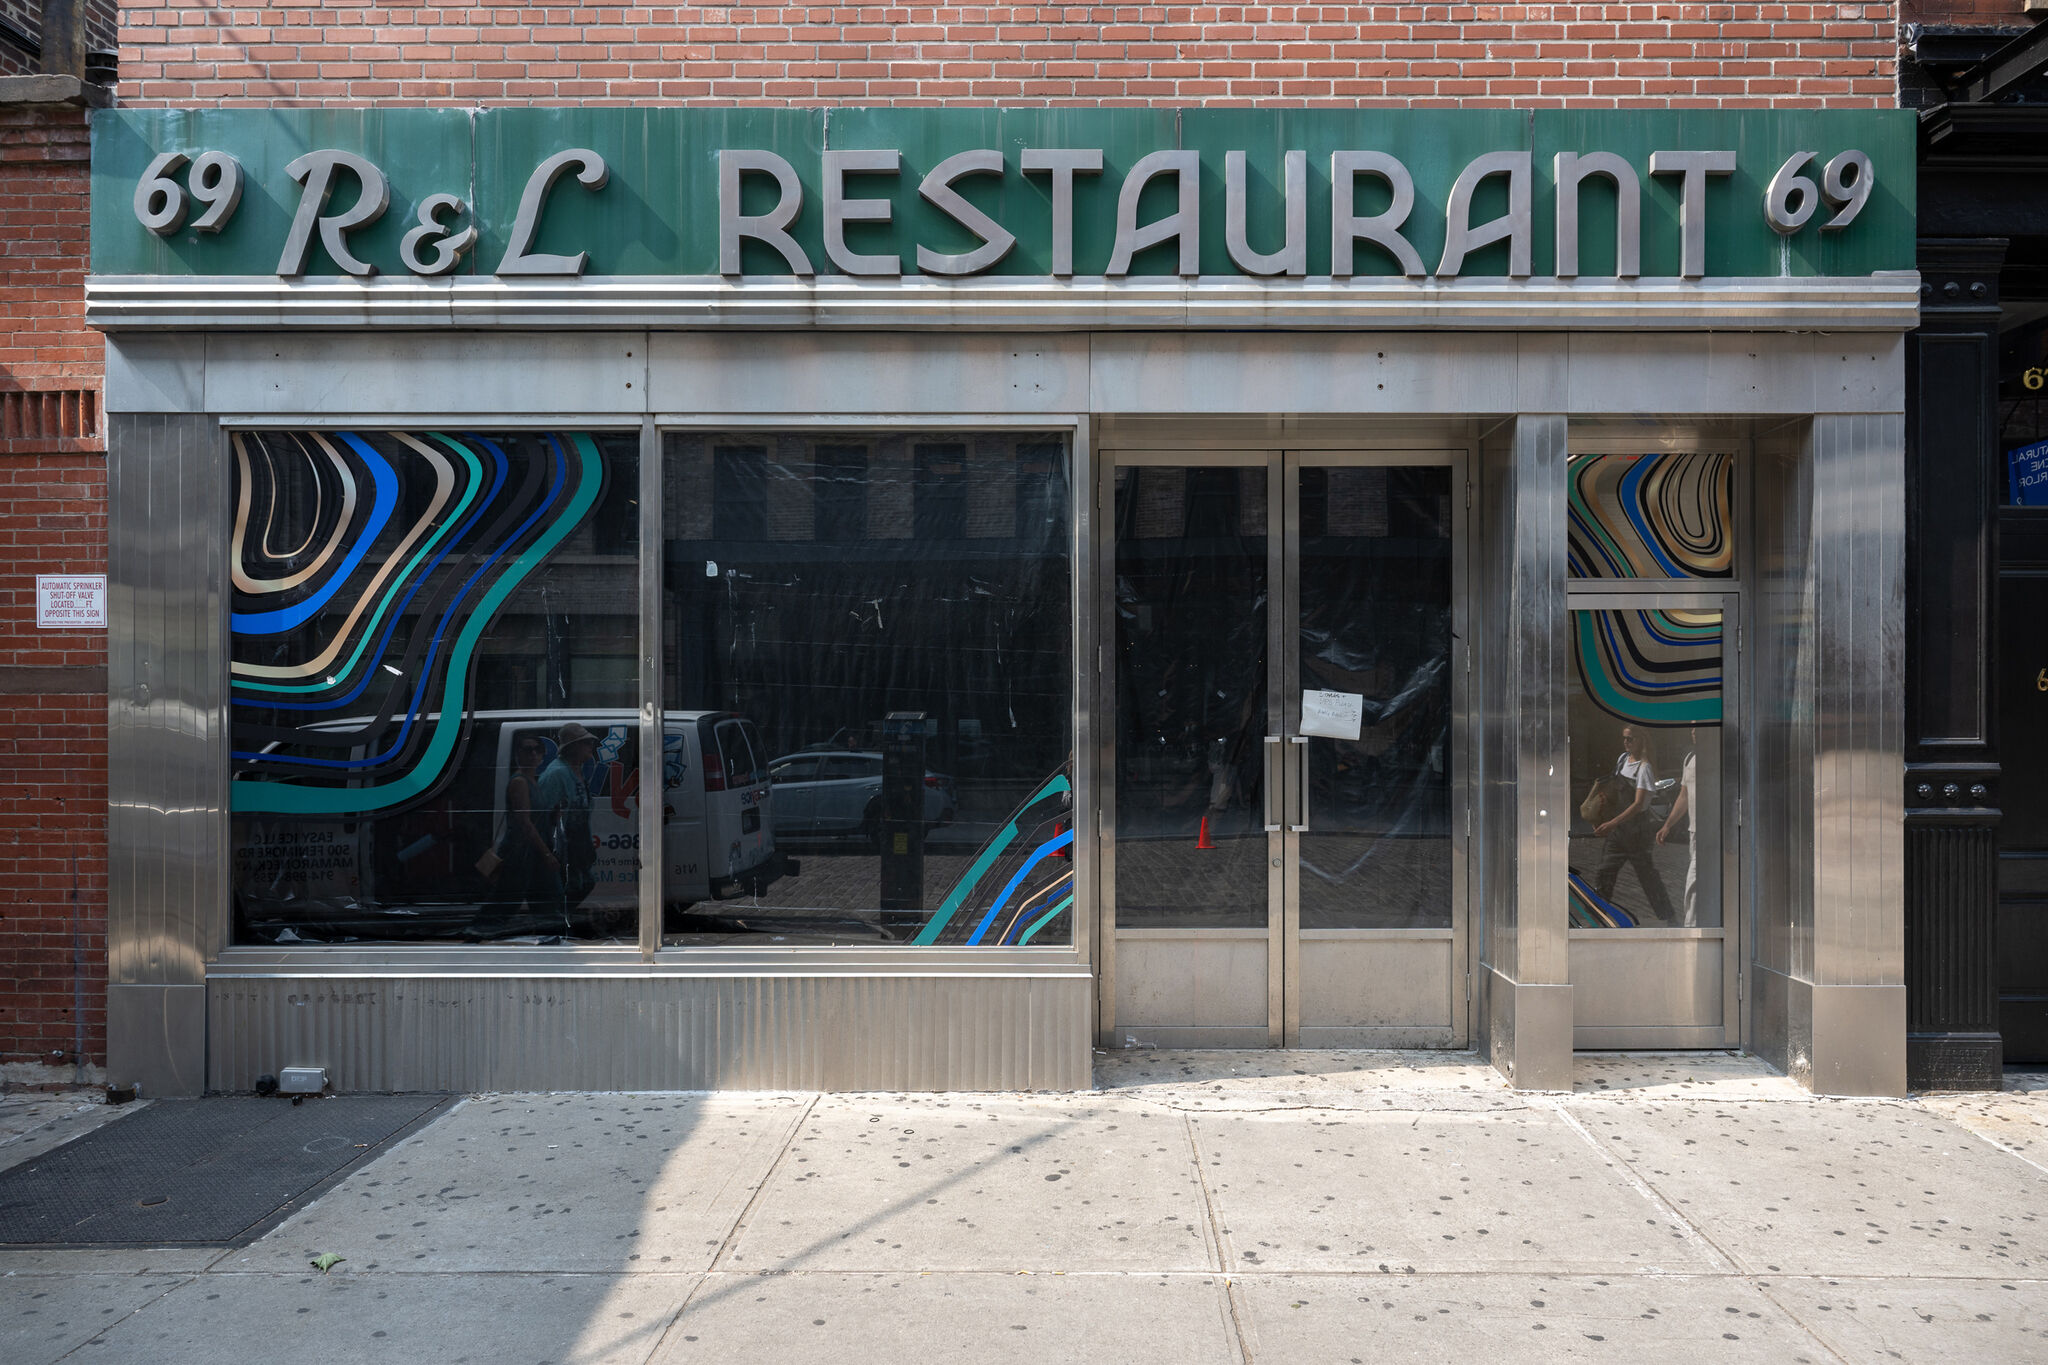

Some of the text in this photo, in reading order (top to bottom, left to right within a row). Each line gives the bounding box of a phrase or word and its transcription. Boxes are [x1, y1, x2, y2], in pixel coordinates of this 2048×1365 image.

[133, 150, 244, 237] 69
[719, 148, 1736, 277] RESTAURANT
[1763, 150, 1875, 235] 69
[41, 582, 103, 590] AUTOMATIC SPRINKLER
[50, 591, 94, 599] SHUT-OFF VALVE
[45, 609, 100, 617] OPPOSITE THIS SIGN
